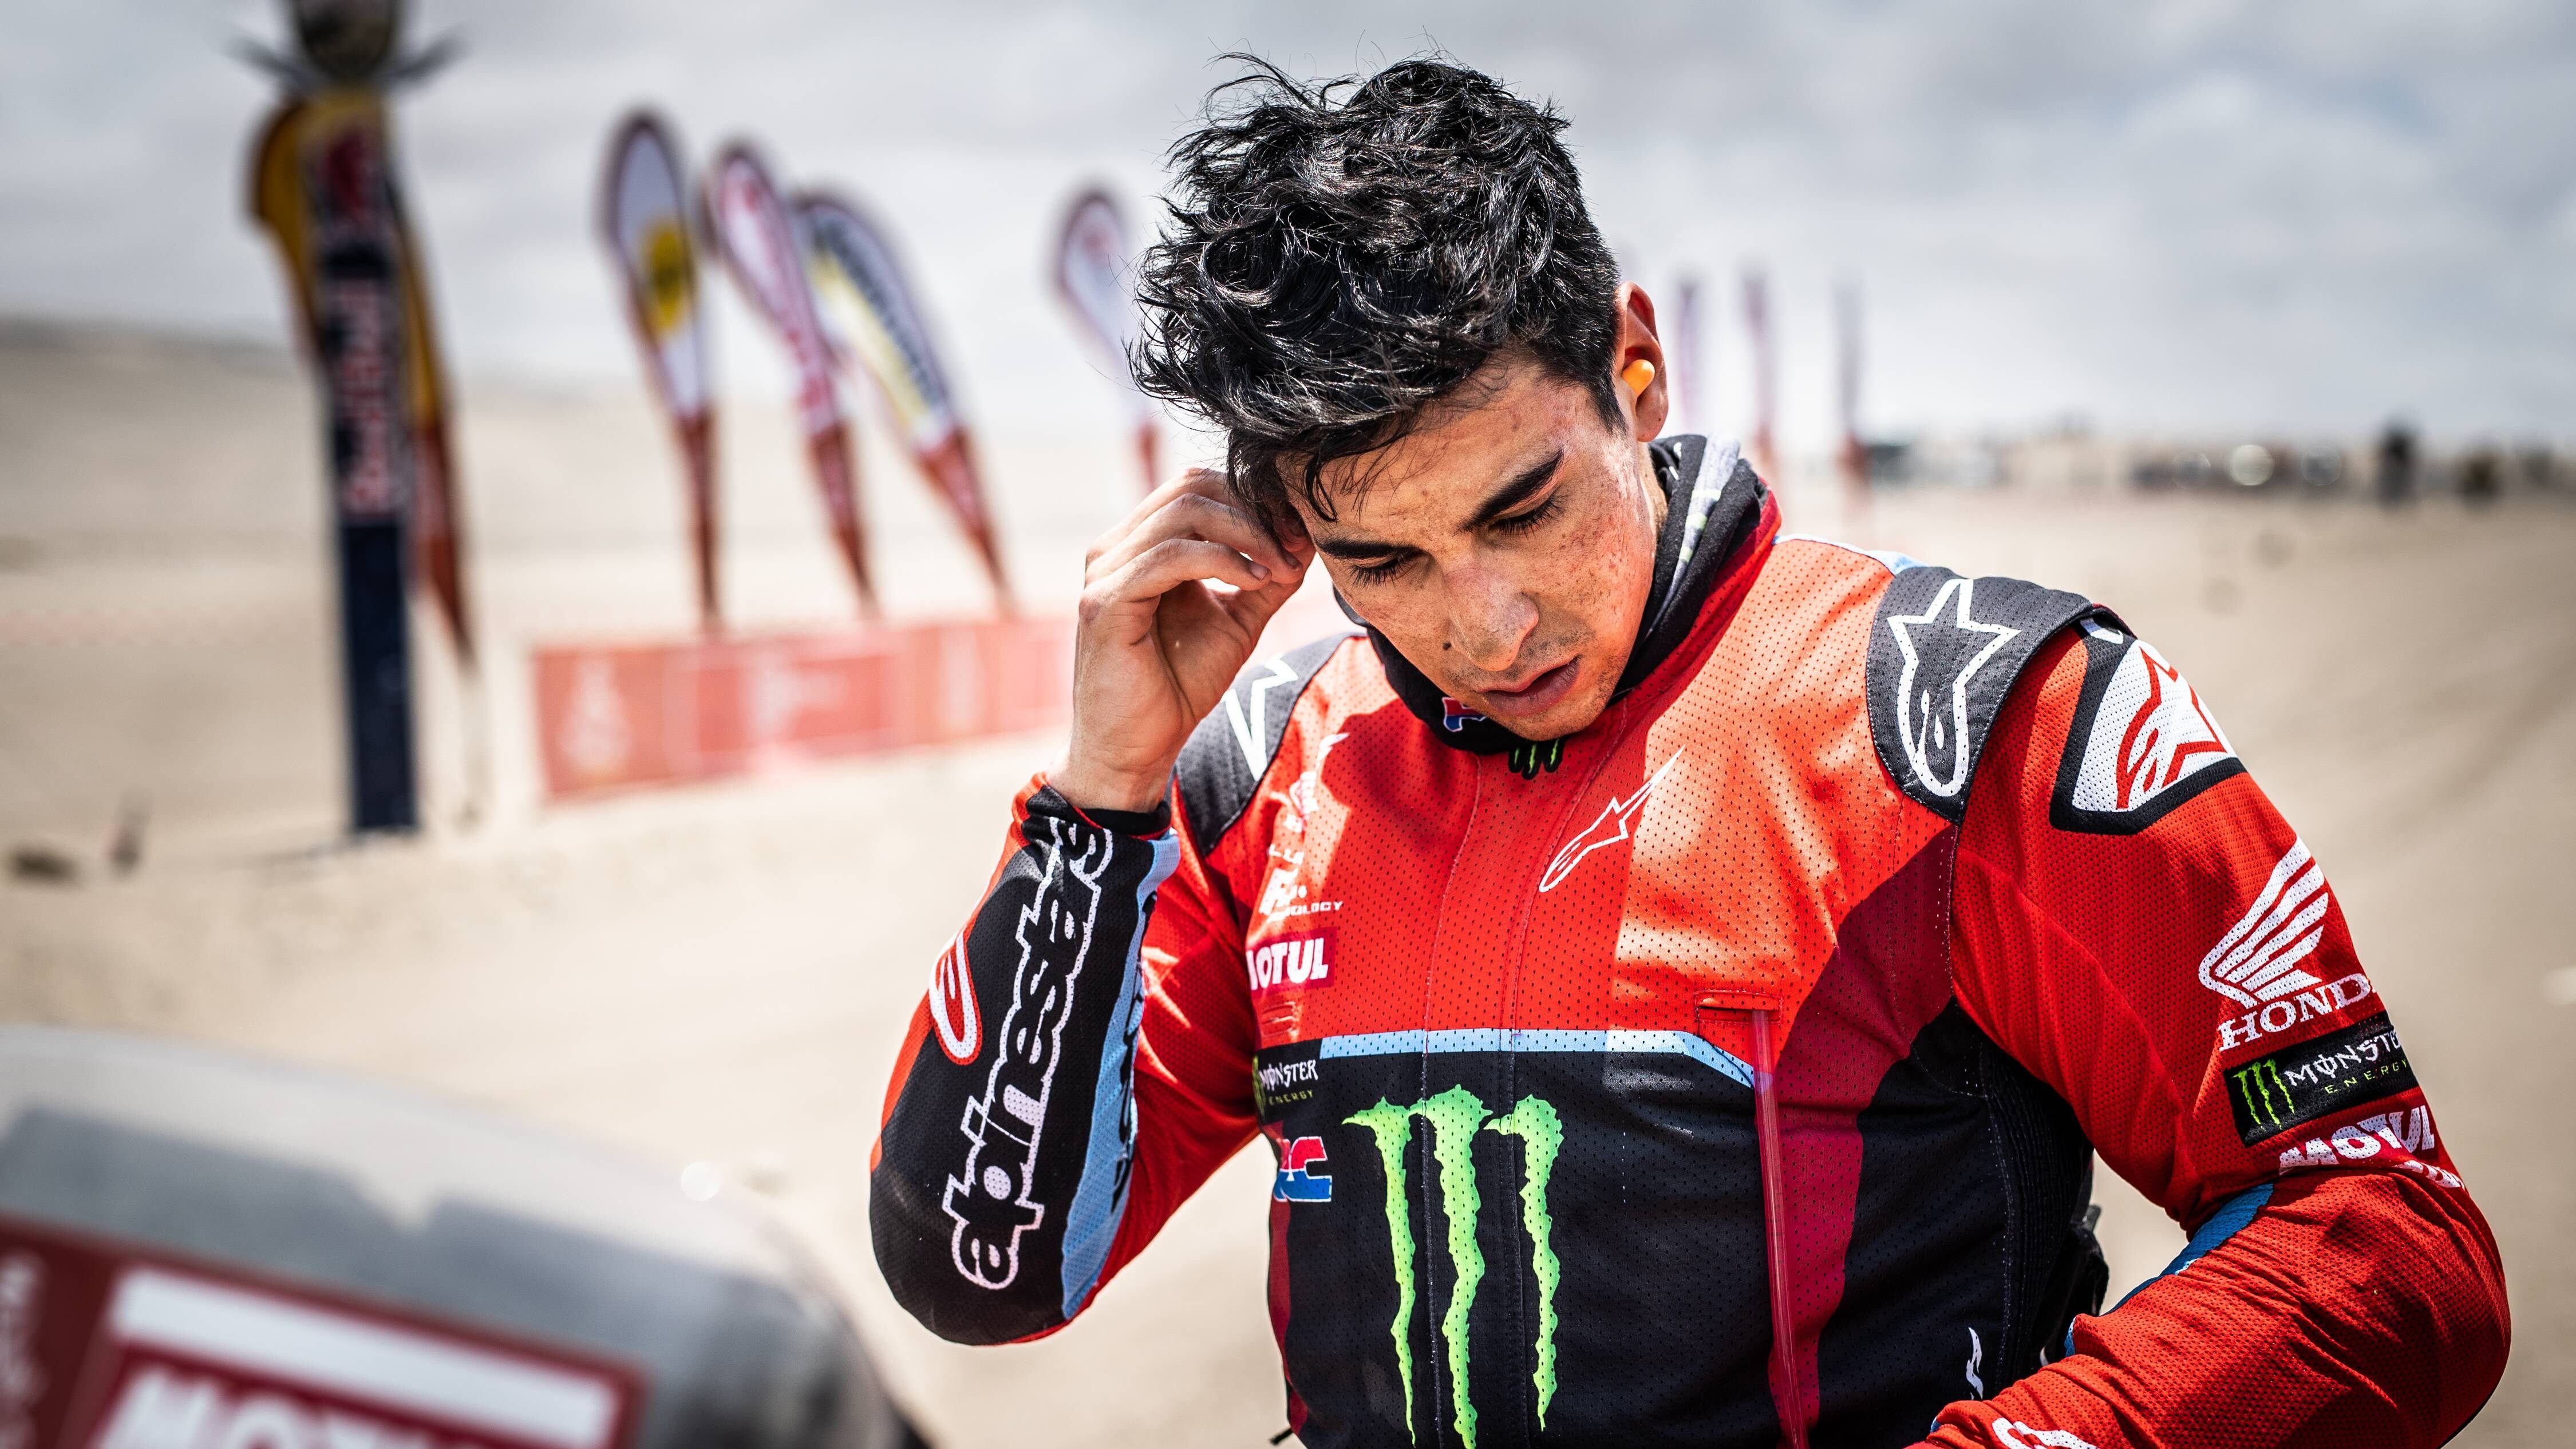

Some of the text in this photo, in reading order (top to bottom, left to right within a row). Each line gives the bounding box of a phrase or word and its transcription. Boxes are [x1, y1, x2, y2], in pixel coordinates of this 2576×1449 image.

[2217, 973, 2376, 1051] HOND
[942, 816, 1113, 1290] alpinestars
[2279, 1105, 2435, 1175] MOTUL
